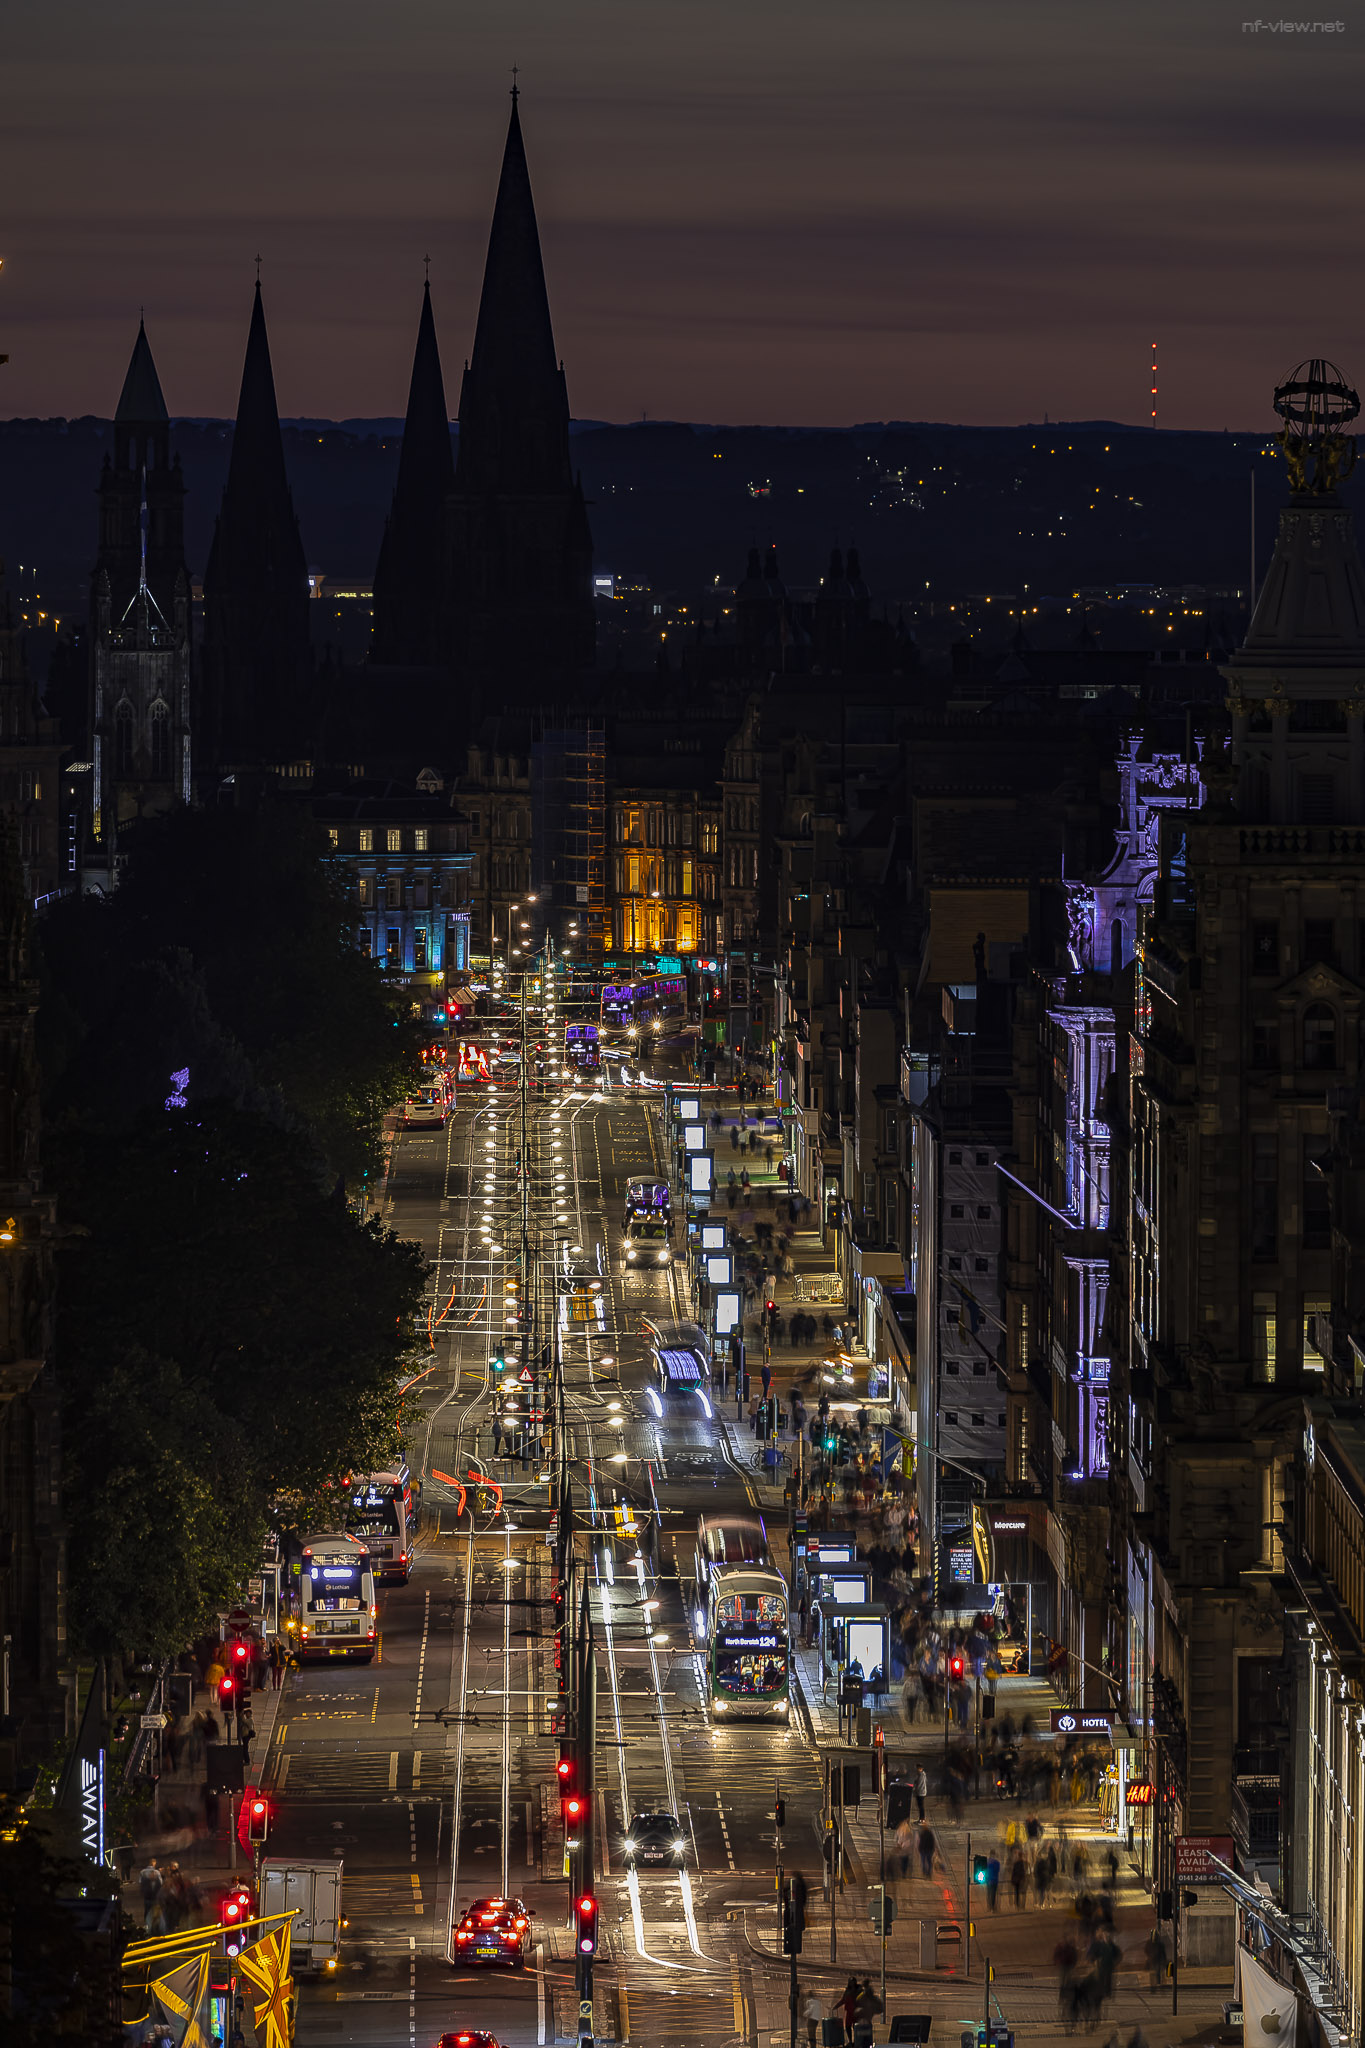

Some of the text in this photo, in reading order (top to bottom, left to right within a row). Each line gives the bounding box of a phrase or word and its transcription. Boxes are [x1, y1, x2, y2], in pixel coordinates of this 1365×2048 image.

[994, 1521, 1026, 1529] Mercure
[759, 1636, 776, 1647] 124
[1082, 1718, 1109, 1727] HOTEL
[1126, 1785, 1151, 1803] H&M
[82, 1785, 98, 1864] WAV
[1178, 1849, 1207, 1857] LEASE
[1178, 1857, 1232, 1866] AVAILAE
